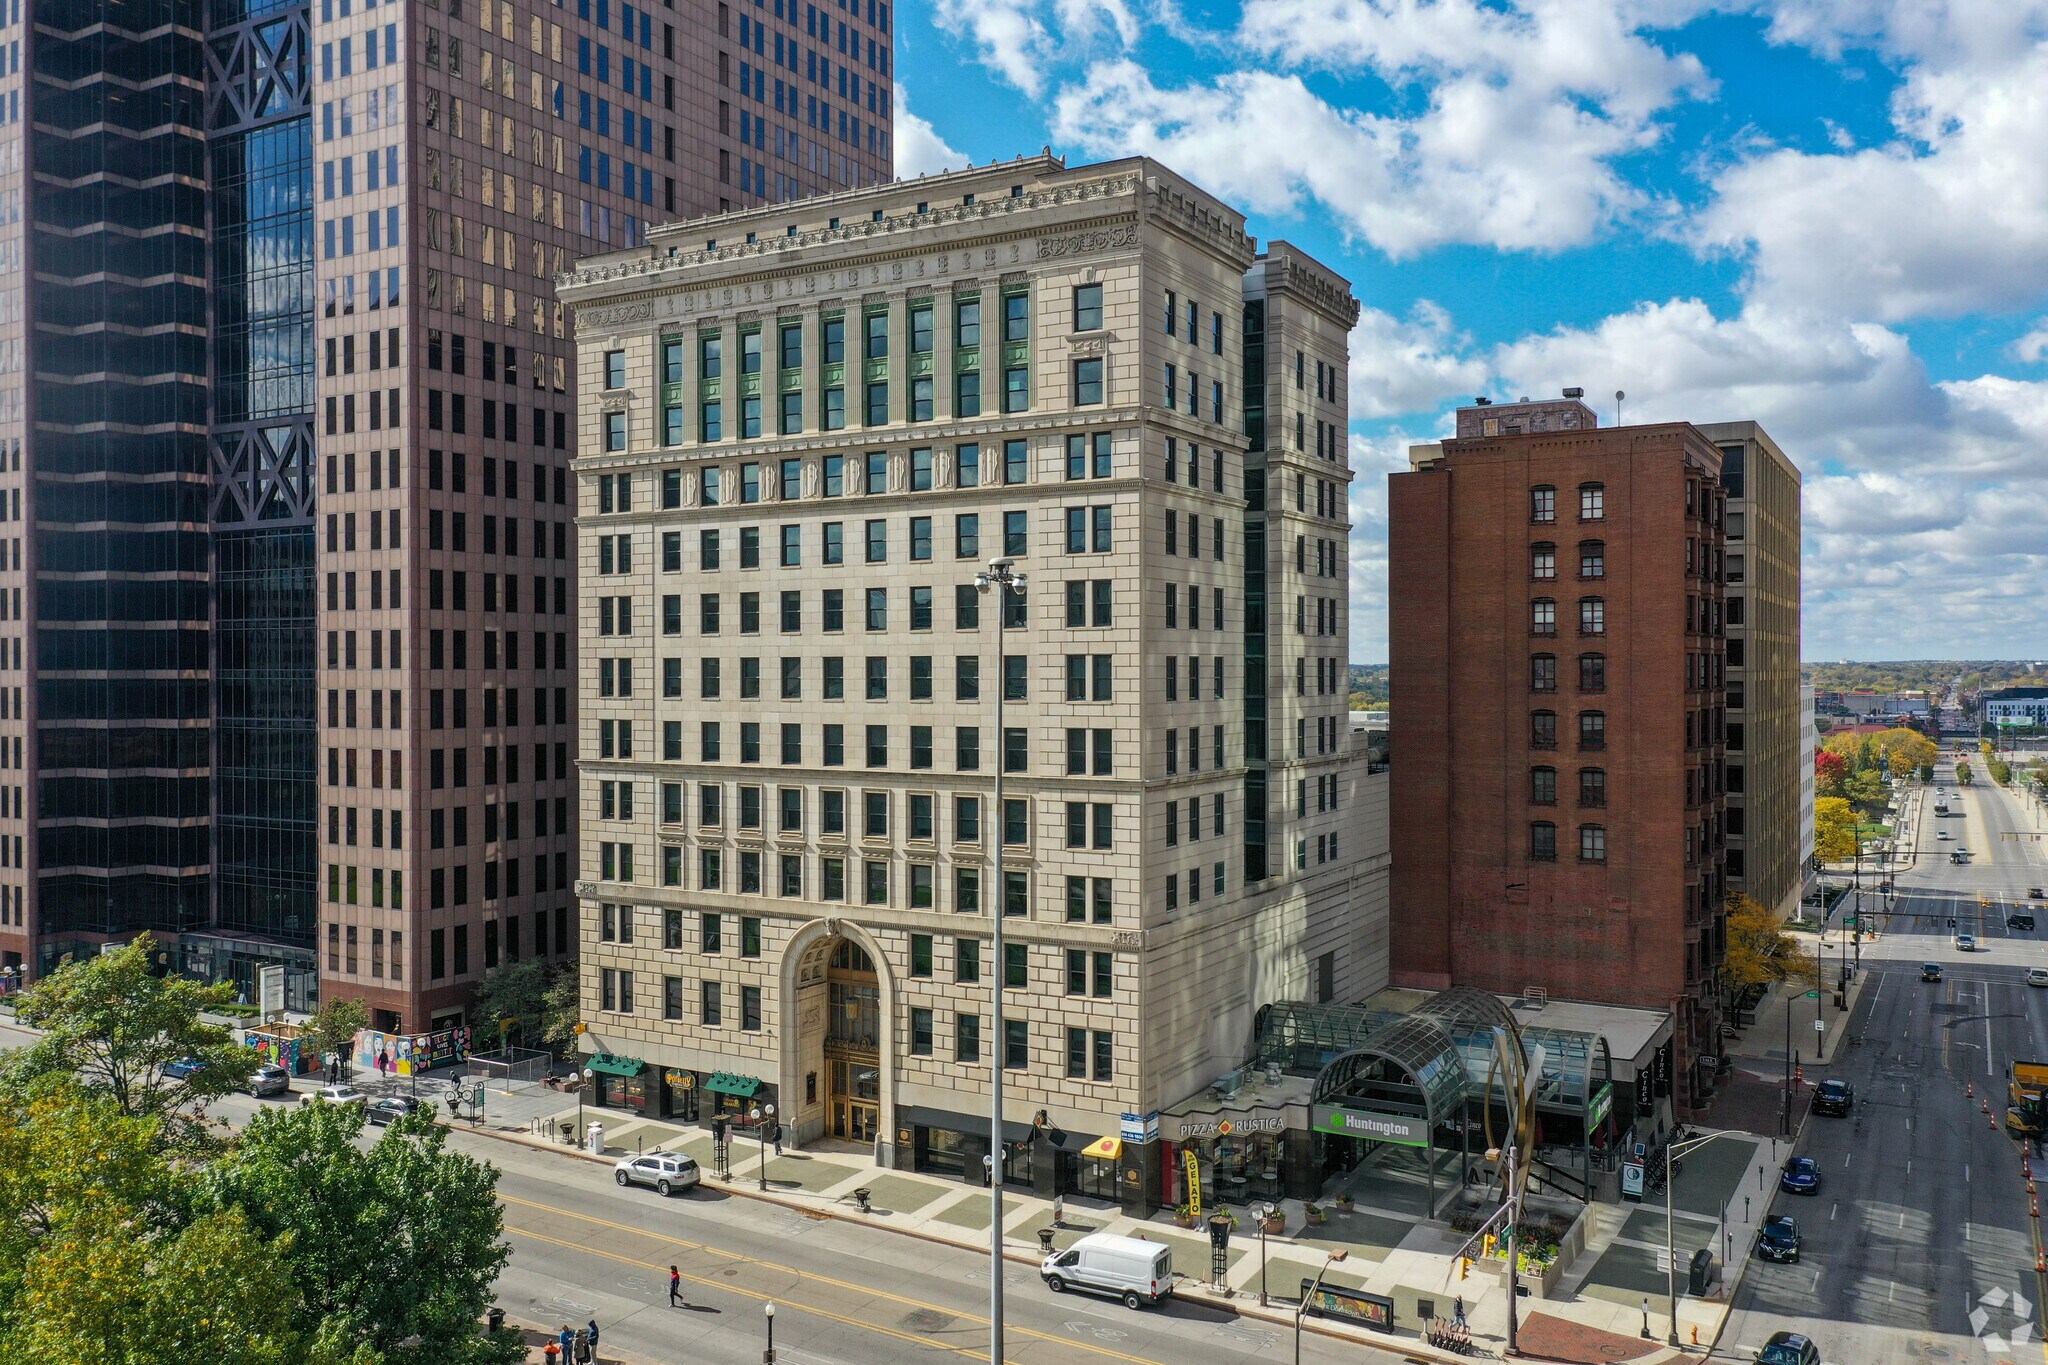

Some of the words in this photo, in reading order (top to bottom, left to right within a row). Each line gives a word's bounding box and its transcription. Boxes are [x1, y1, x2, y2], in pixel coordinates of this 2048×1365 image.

[1641, 1070, 1649, 1103] Cinco
[1180, 1123, 1215, 1137] PIZZA
[1236, 1117, 1285, 1132] RUSTICA
[1345, 1114, 1409, 1136] Huntington
[1189, 1162, 1199, 1212] GELATO
